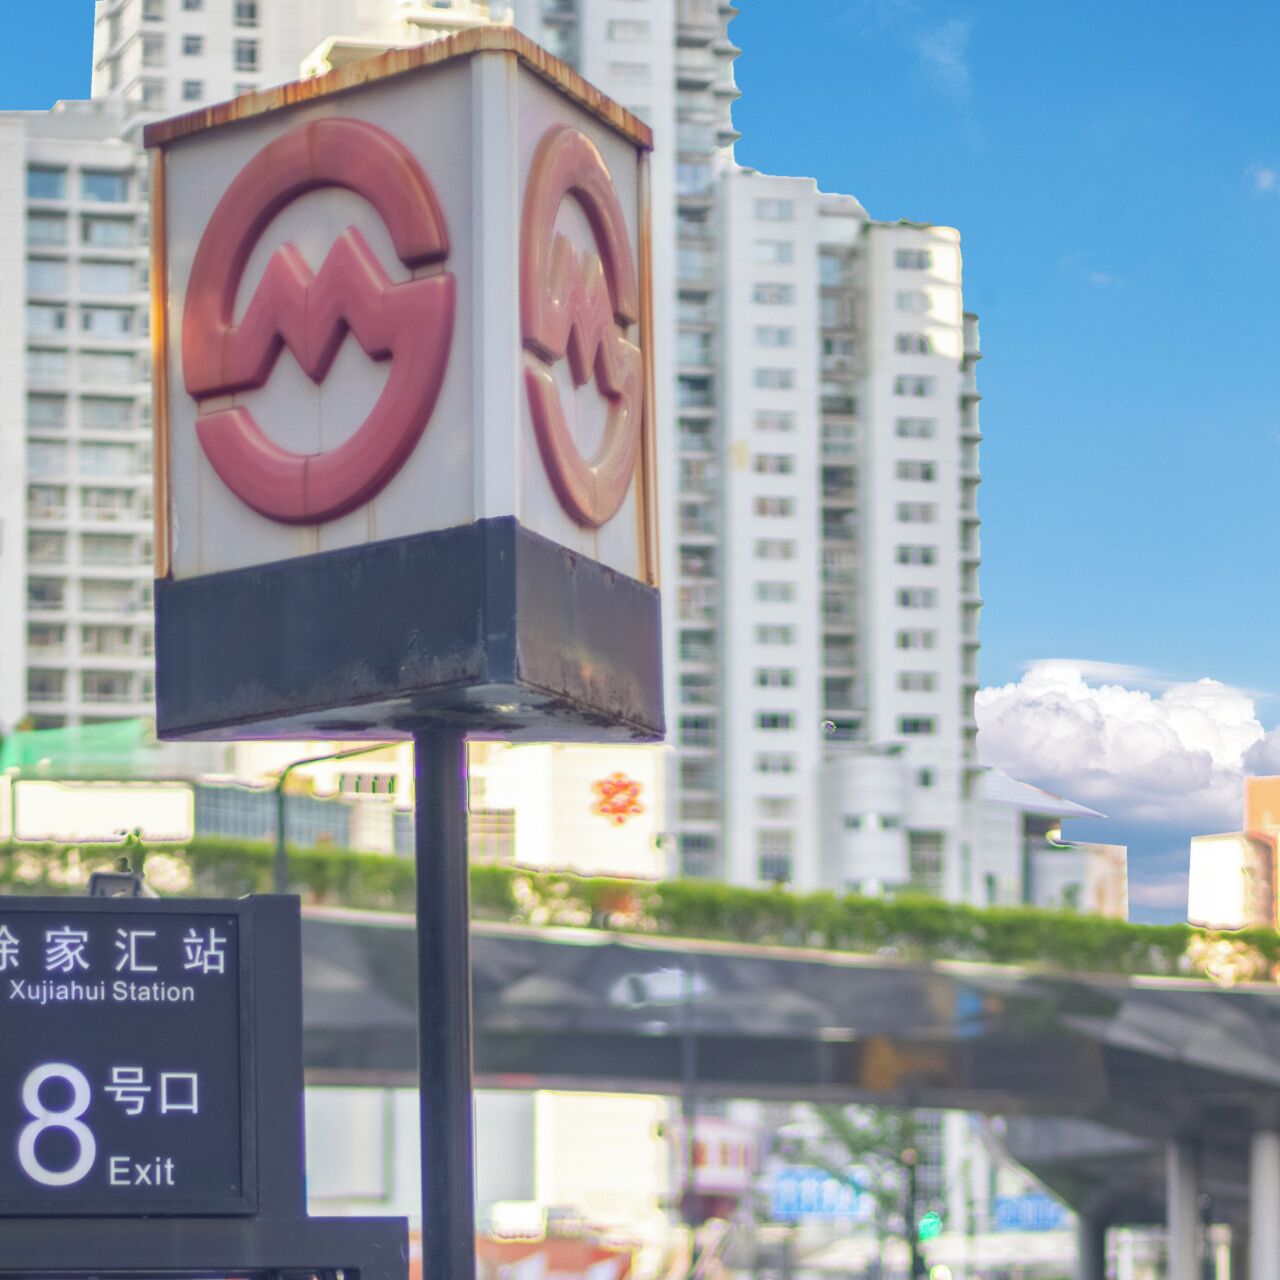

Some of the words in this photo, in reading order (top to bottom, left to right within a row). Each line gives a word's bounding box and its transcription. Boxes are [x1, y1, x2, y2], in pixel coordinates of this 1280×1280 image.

[9, 979, 106, 1005] Xujiahui
[112, 980, 195, 1002] Station
[17, 1062, 97, 1187] 8
[104, 1066, 200, 1116] 号口
[109, 1156, 175, 1186] Exit
